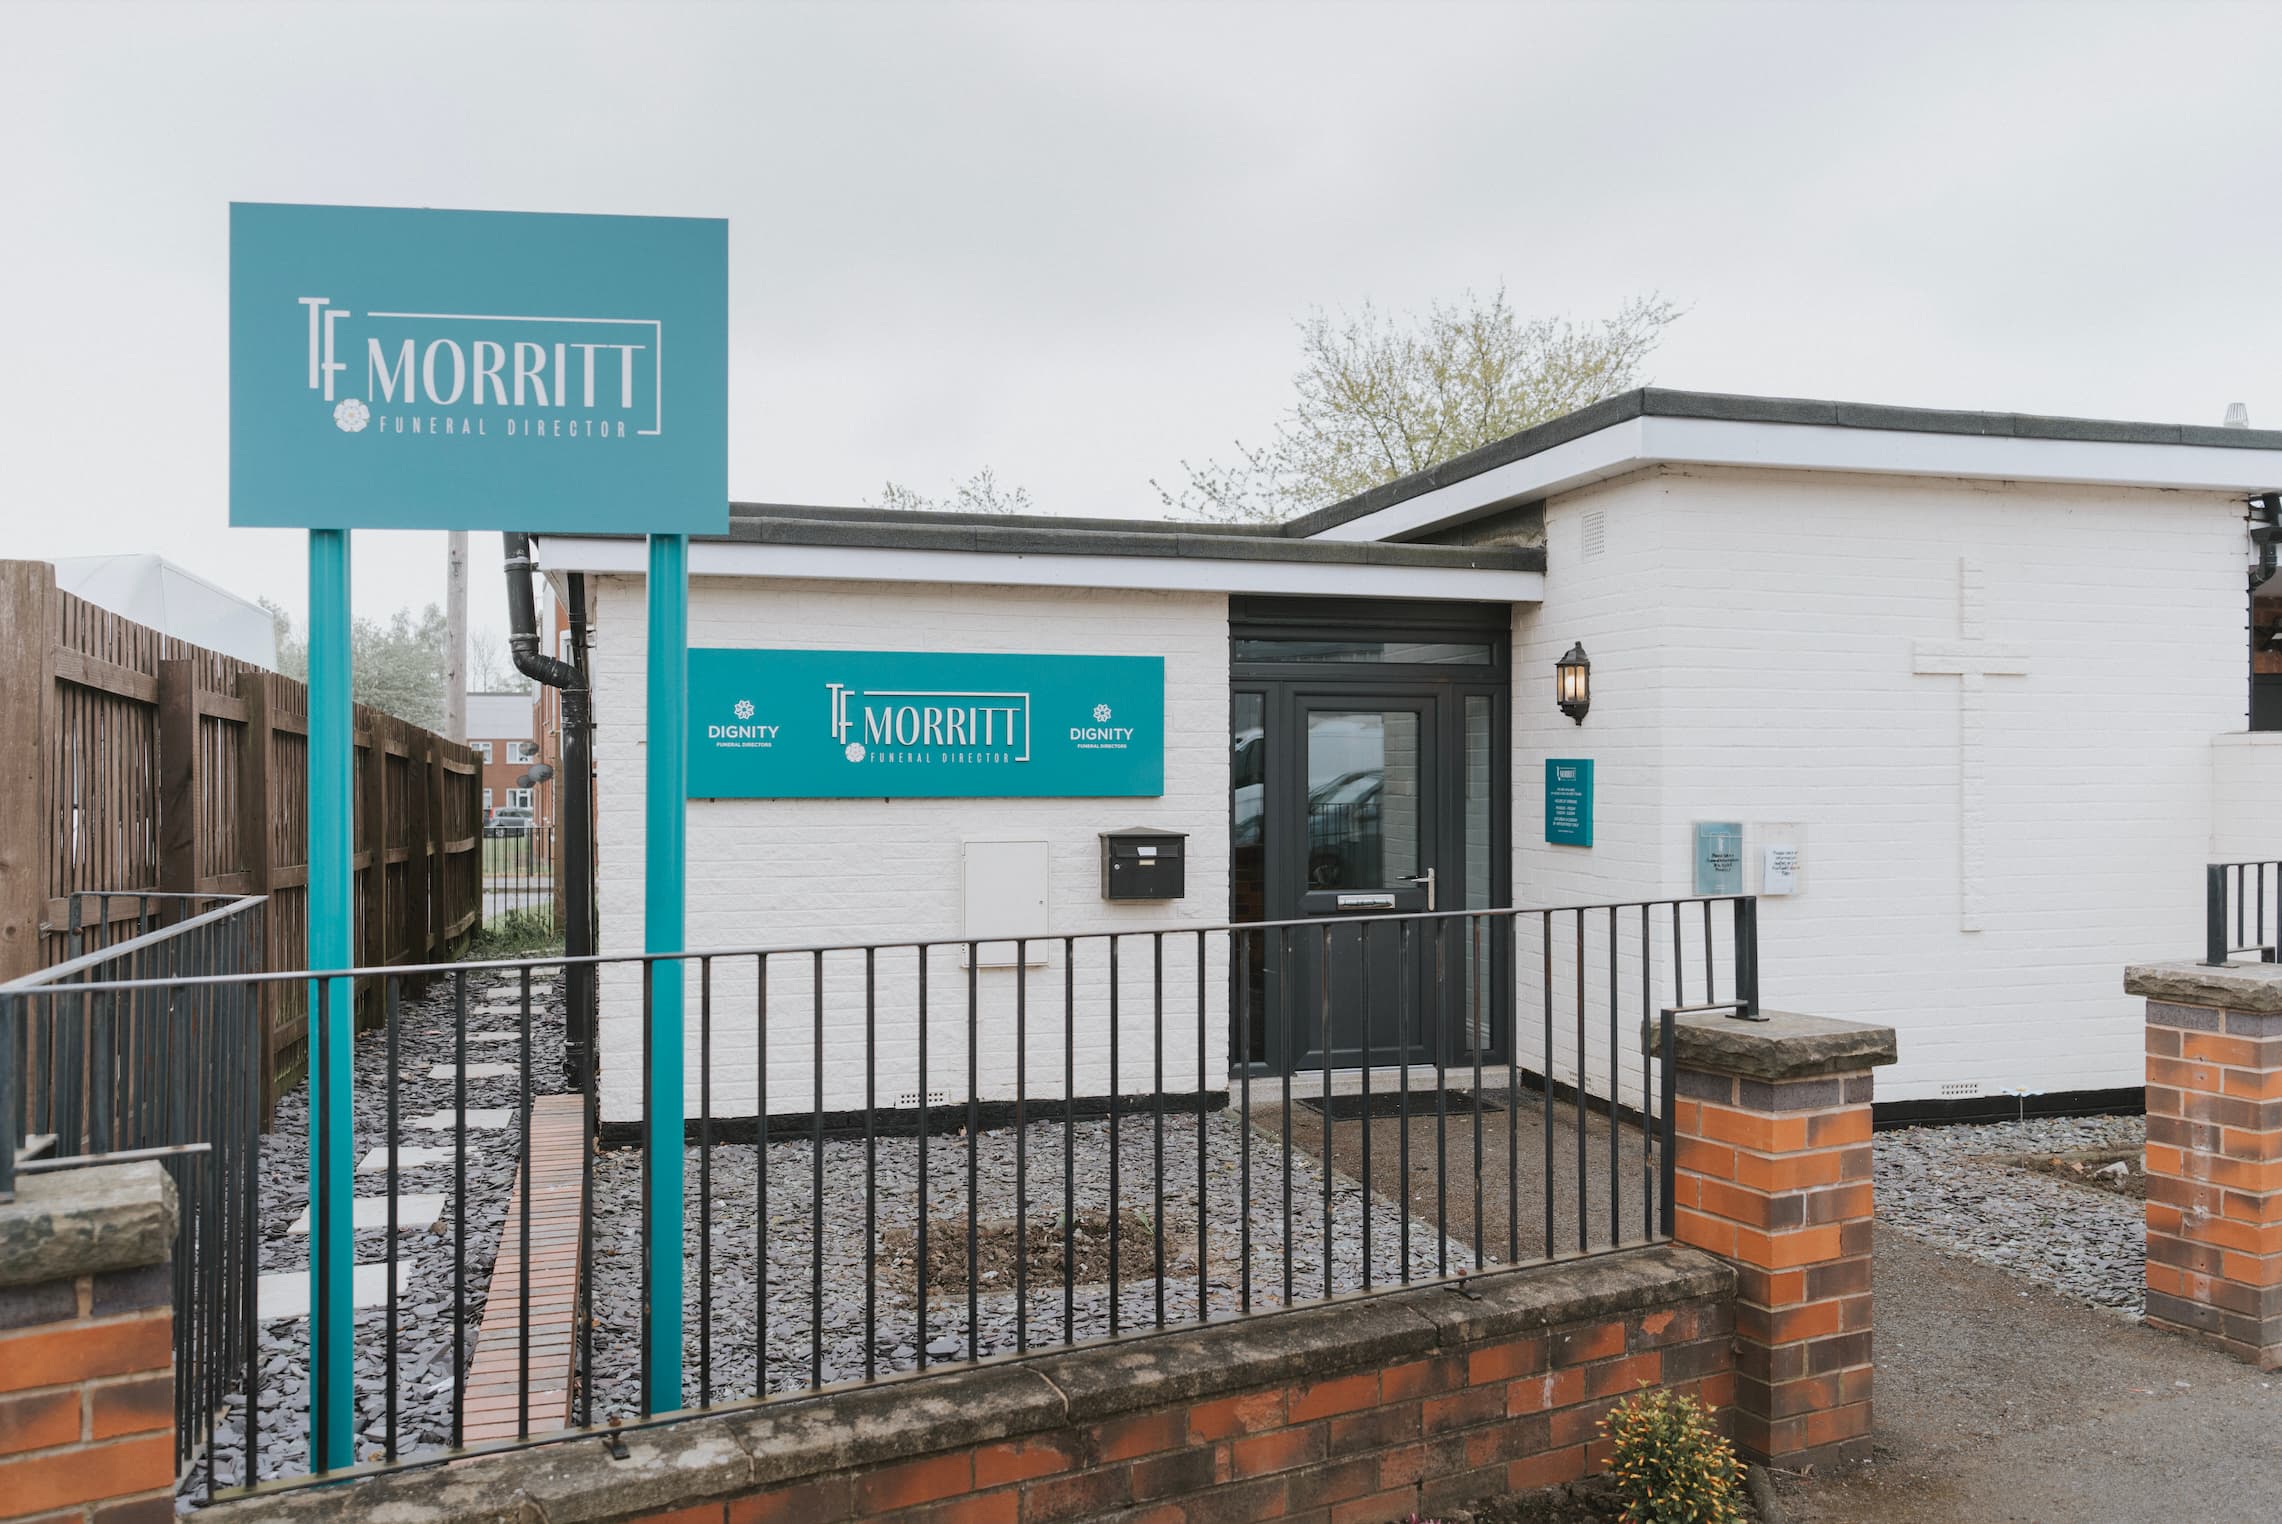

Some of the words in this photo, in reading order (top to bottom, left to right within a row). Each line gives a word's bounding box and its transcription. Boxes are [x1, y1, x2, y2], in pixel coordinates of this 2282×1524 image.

[367, 338, 647, 408] MORRITT
[379, 416, 487, 435] FUNERAL
[507, 419, 625, 437] DIRECTOR
[708, 725, 779, 739] DIGNITY
[864, 706, 1021, 746] MORRITT
[1070, 727, 1134, 741] DIGNITY
[870, 752, 931, 764] FUNERAL
[942, 752, 1009, 764] DIRECTOR
